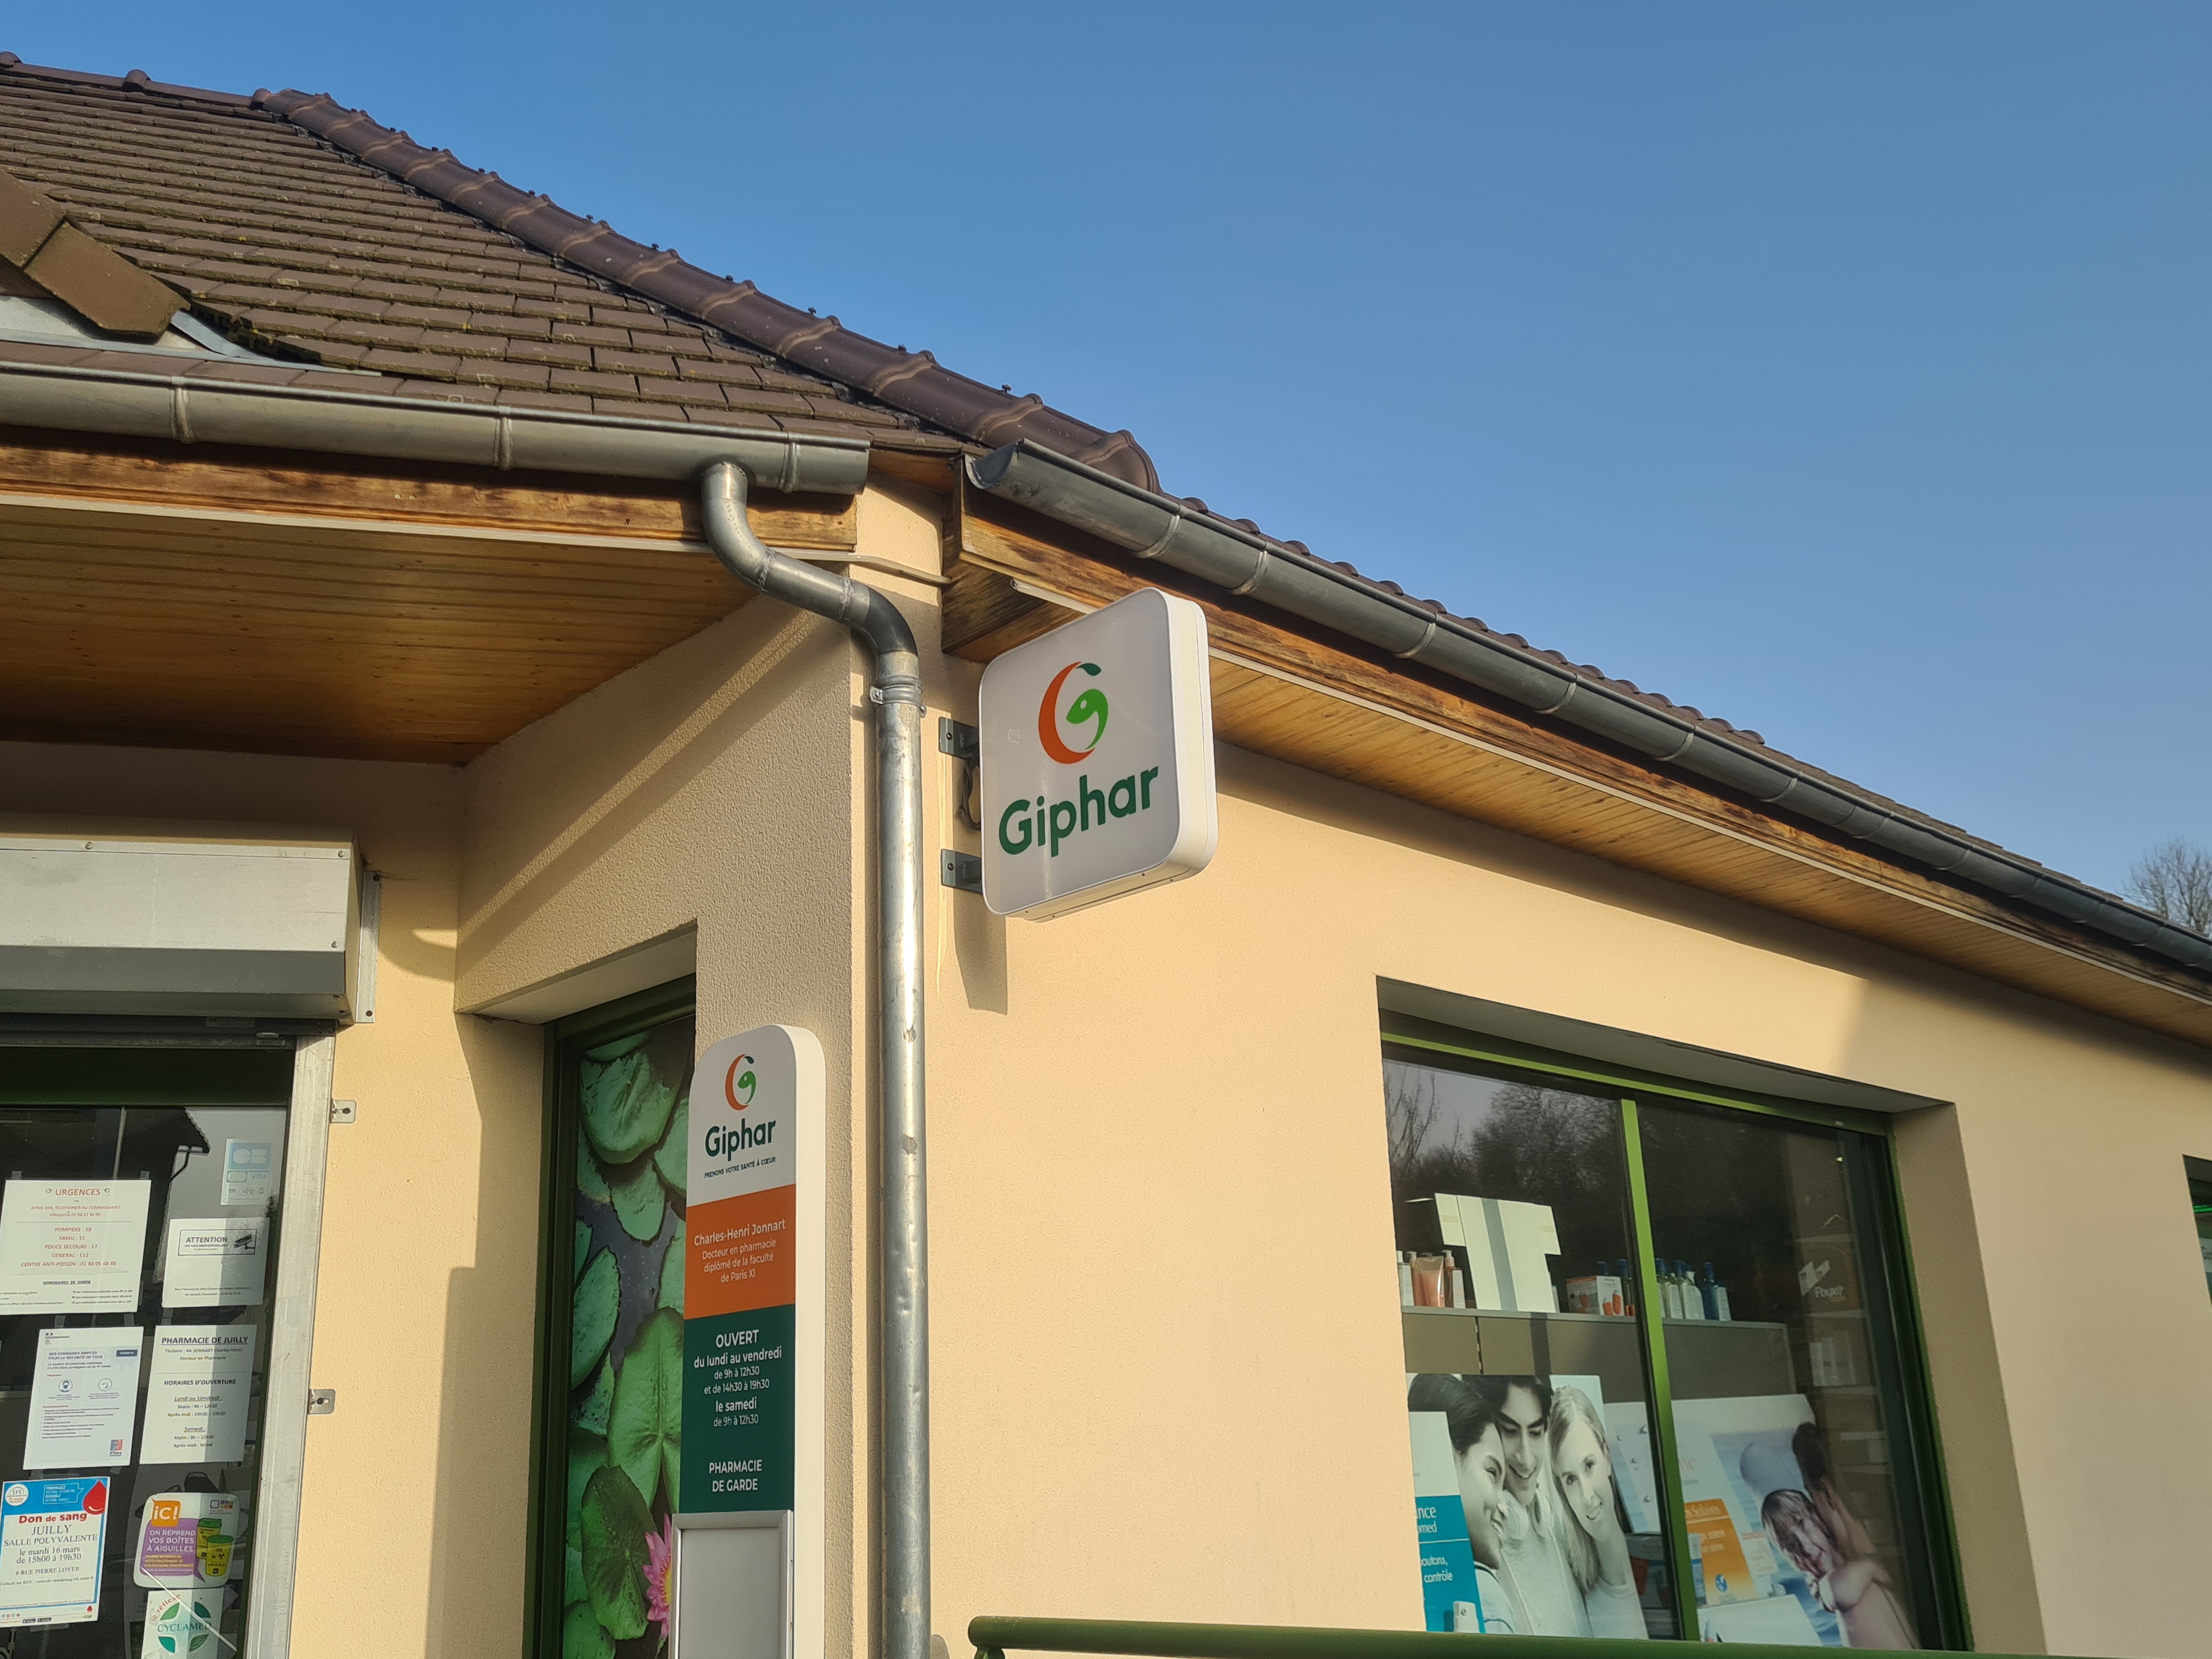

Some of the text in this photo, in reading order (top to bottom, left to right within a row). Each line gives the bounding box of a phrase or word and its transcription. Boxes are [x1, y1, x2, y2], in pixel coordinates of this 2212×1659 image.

[998, 766, 1159, 857] Giphar
[705, 1118, 776, 1162] Giphar
[704, 1156, 776, 1178] PRENONS VOTRE SANTÉ À CŒUR
[694, 1219, 786, 1246] Charles-Henri Jonnart
[702, 1238, 776, 1260] Docteur en pharmacie
[704, 1251, 774, 1273] diplômé de la faculté
[720, 1268, 755, 1283] de Paris XI
[715, 1329, 759, 1348] OUVERT
[694, 1346, 782, 1368] du lundi au vendredi
[714, 1365, 760, 1380] de 9h à 12h30
[704, 1378, 770, 1395] et de 14h30 à 19h30
[715, 1396, 757, 1413] le samedi
[713, 1414, 759, 1427] de 9h à 12h30
[709, 1459, 762, 1474] PHARMACIE
[712, 1479, 758, 1492] DE GARDE
[19, 1515, 42, 1524] Don
[59, 1513, 87, 1521] sang
[31, 1524, 72, 1536] JUILLY
[3, 1533, 98, 1547] SALLE POLYVALENTE
[147, 1543, 153, 1551] À
[28, 1547, 49, 1555] mardi
[1420, 1556, 1448, 1567] outons,
[1424, 1569, 1453, 1583] contrôle
